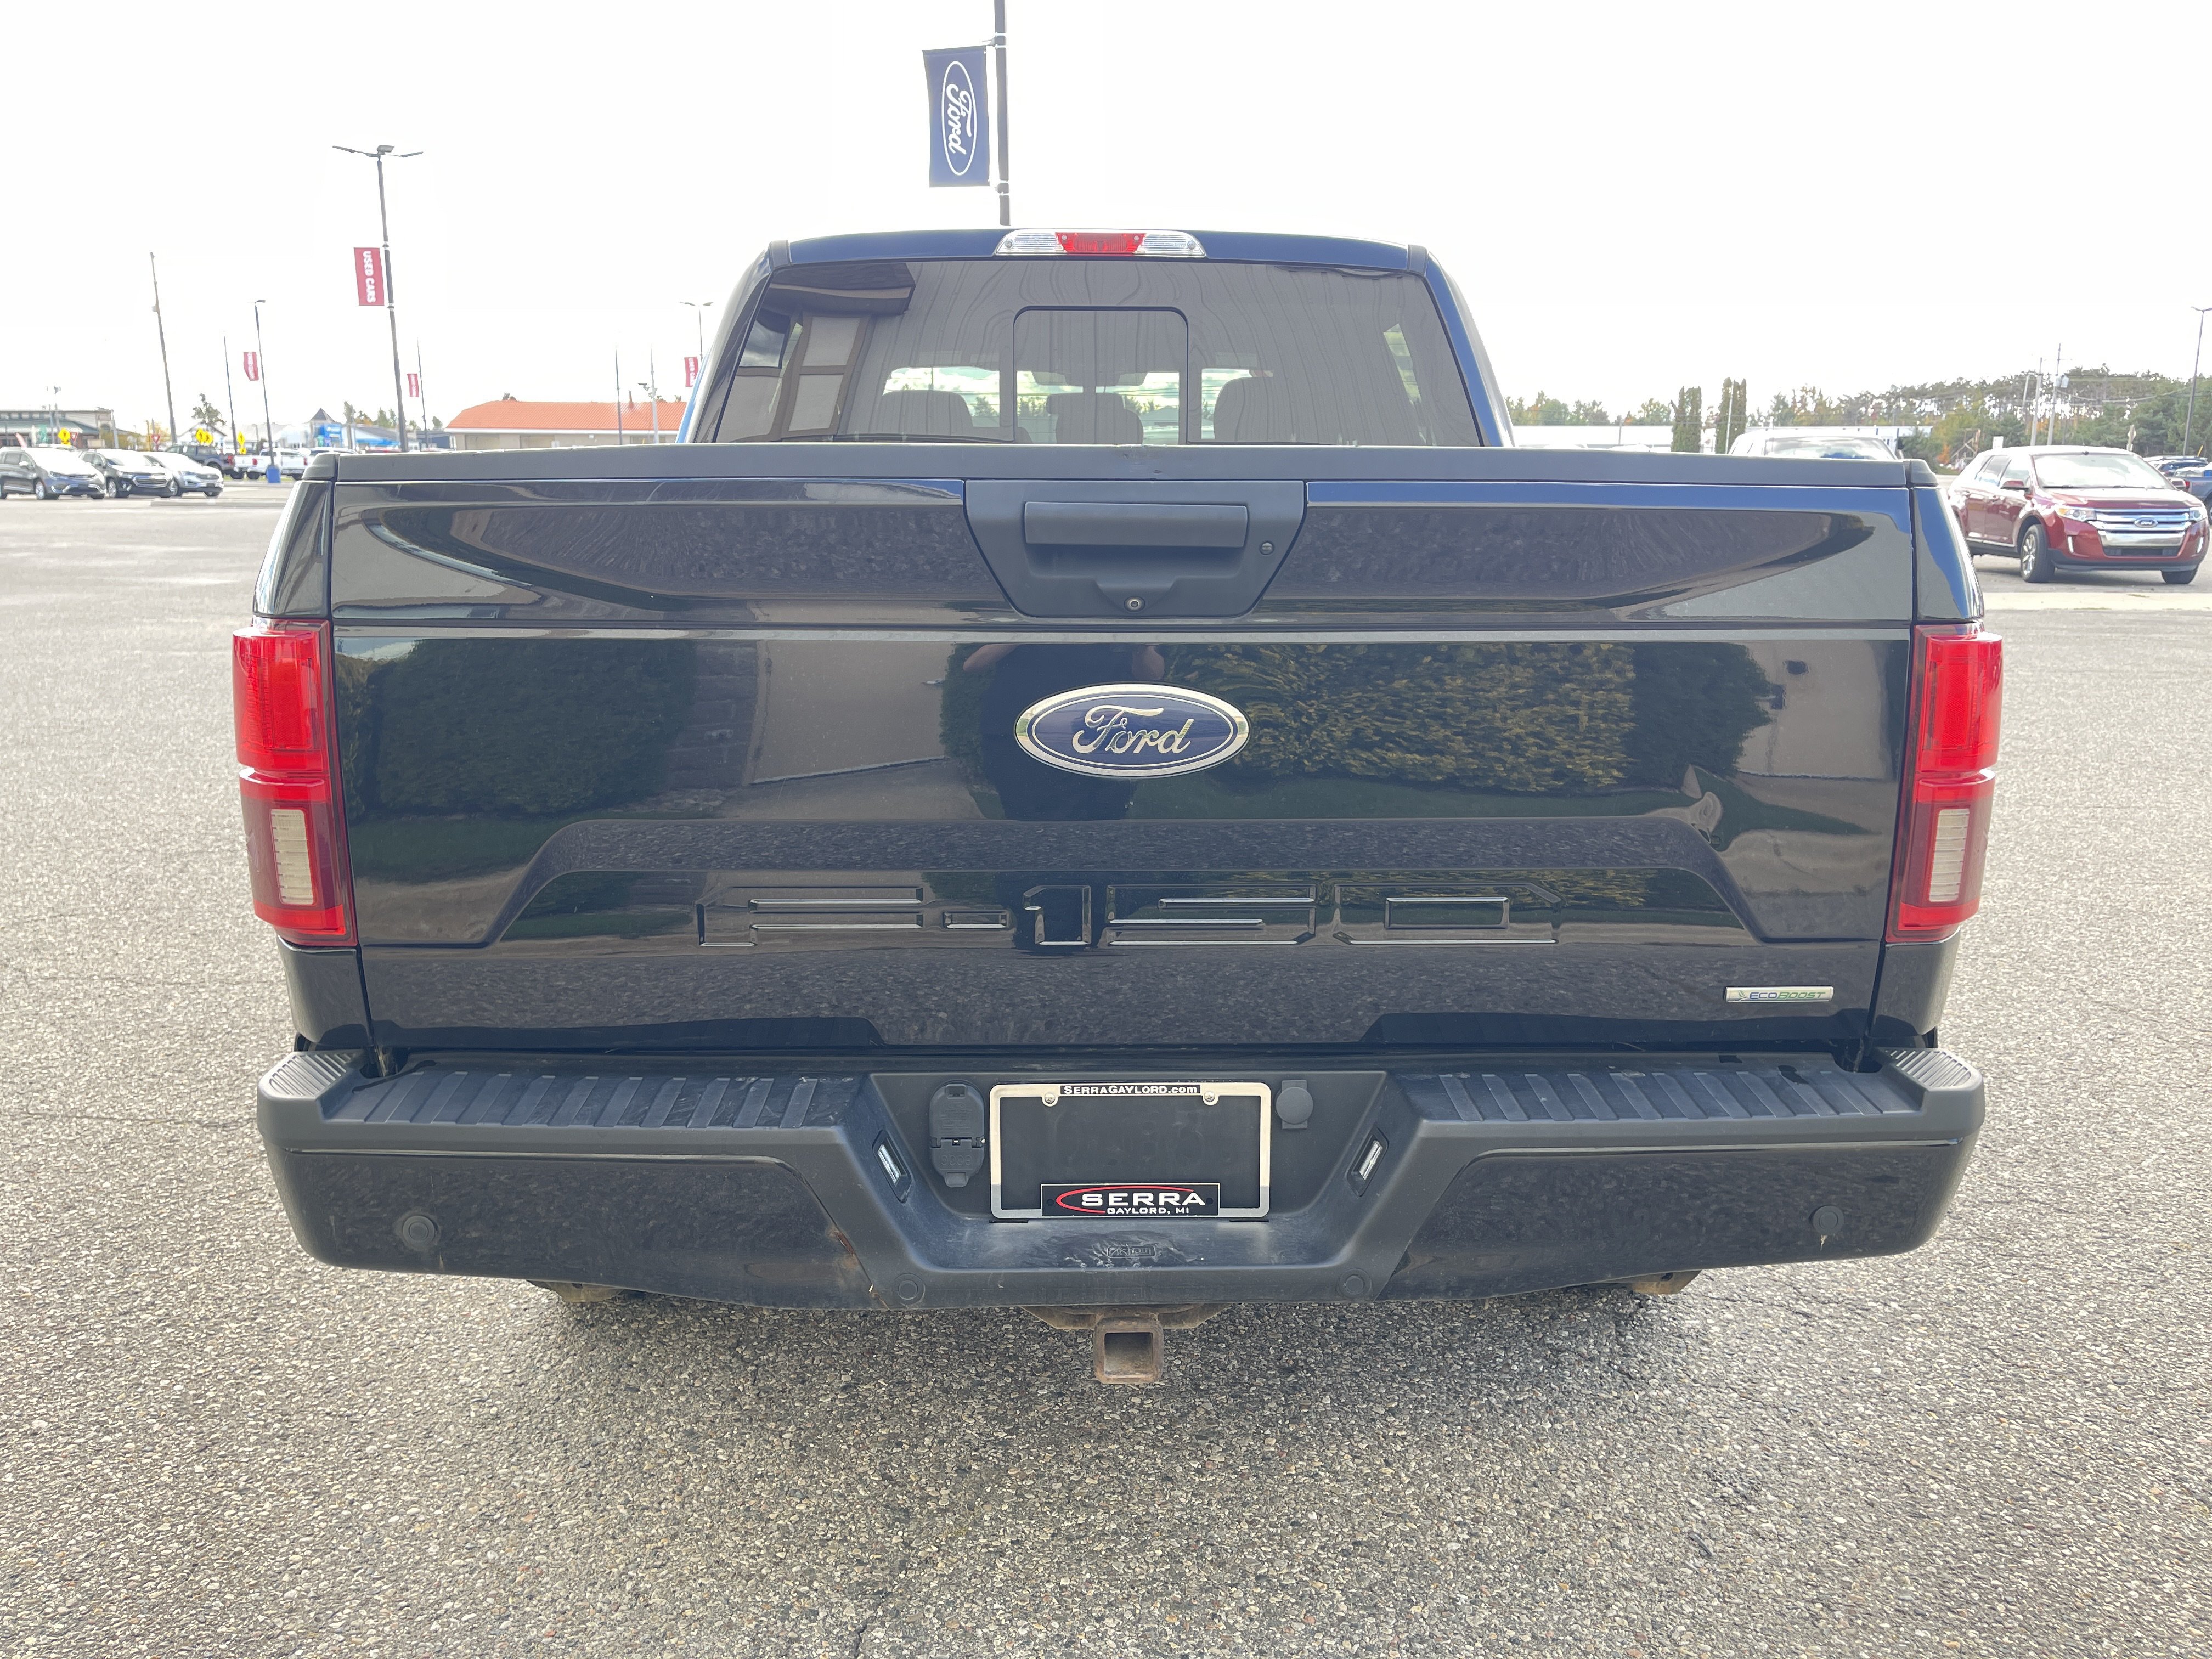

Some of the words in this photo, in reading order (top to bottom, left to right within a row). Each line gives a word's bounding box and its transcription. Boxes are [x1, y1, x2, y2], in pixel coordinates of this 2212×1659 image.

[946, 83, 972, 155] Ford
[363, 251, 374, 276] USED
[365, 278, 376, 303] CARS
[1072, 704, 1194, 754] Ford
[695, 883, 1564, 947] F-150
[1064, 1085, 1197, 1094] SERRAGAYLORD.com
[1081, 1193, 1206, 1206] SERRA
